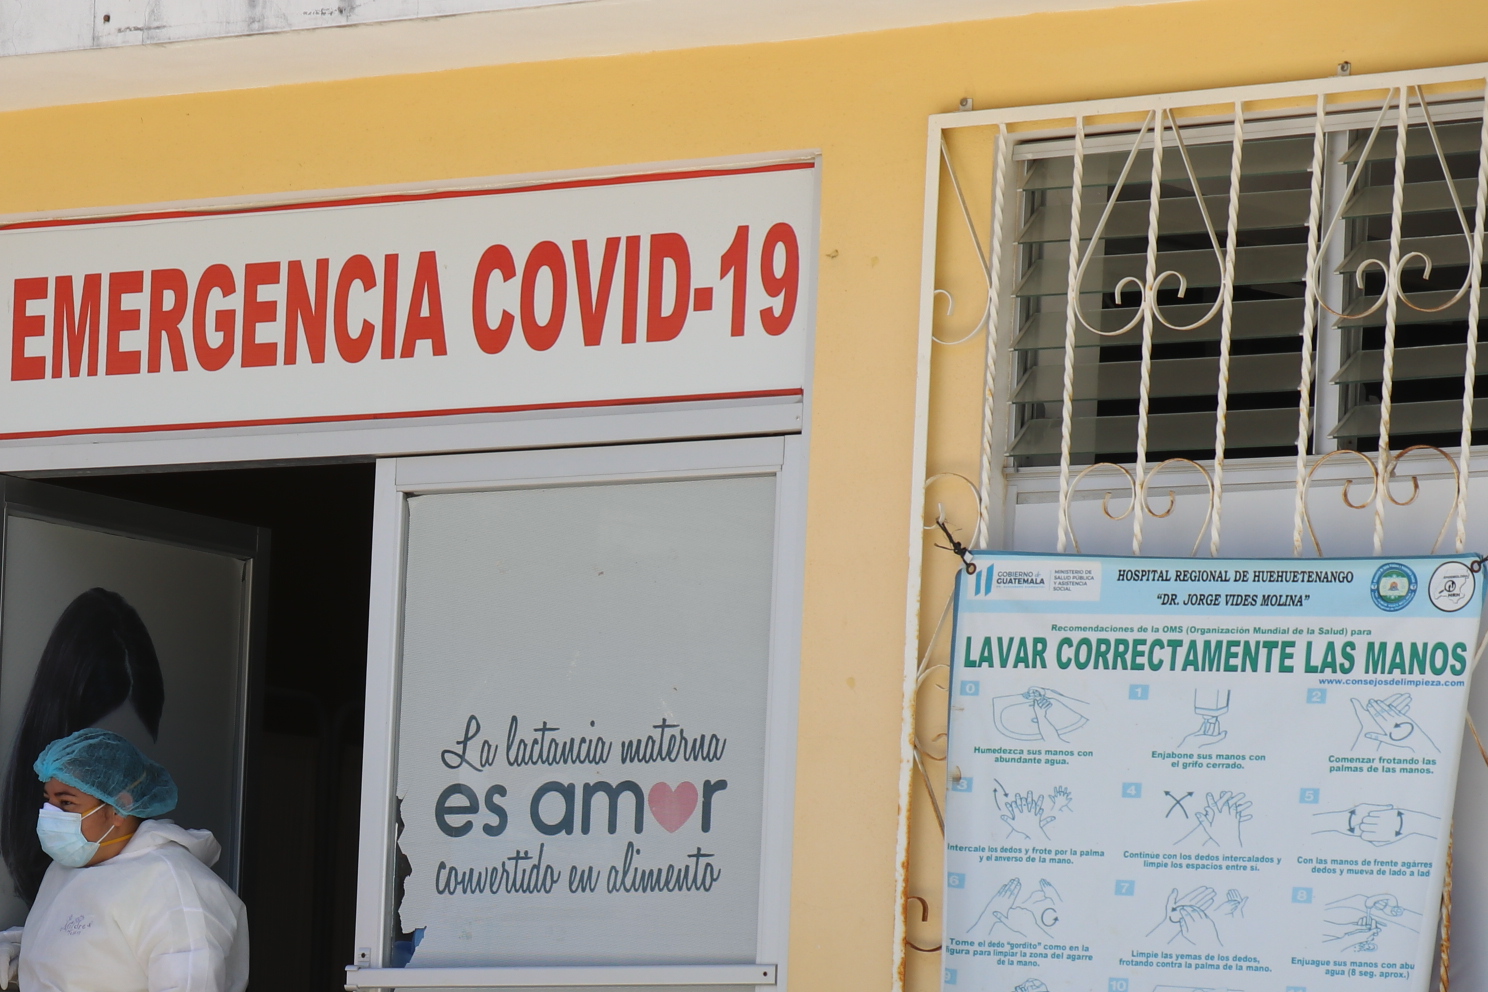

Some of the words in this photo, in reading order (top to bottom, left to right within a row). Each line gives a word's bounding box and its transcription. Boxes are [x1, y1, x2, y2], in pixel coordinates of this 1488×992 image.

[10, 250, 448, 382] EMERGENCIA
[472, 221, 799, 356] COVID-19
[1116, 569, 1171, 581] HOSPITAL
[1174, 569, 1230, 582] REGIONAL
[1233, 570, 1248, 582] DE
[1252, 570, 1353, 582] HUEHUETENANGO
[1183, 593, 1221, 605] JORGE
[1225, 593, 1257, 606] VIDES
[1051, 624, 1134, 632] Recomendaciones
[1137, 625, 1148, 633] de
[1151, 625, 1159, 633] la
[1162, 625, 1183, 633] OMS
[1186, 626, 1249, 635] (Organización
[1253, 626, 1289, 634] Mundial
[1318, 627, 1347, 635] Salud)
[964, 636, 1047, 668] LAVAR
[1056, 638, 1295, 672] CORRECTAMENTE
[1304, 640, 1356, 673] LAS
[1364, 641, 1467, 675] MANOS
[1319, 678, 1464, 686] www.consejosdelimpieza.com
[966, 683, 975, 693] 0
[1135, 687, 1142, 697] 1
[1312, 691, 1321, 702] 2
[441, 714, 498, 772] La
[506, 715, 612, 767] lactancia
[620, 717, 726, 764] materna
[973, 746, 1023, 754] Humedezca
[1151, 750, 1194, 759] Enjabone
[994, 755, 1042, 763] abundante
[1044, 758, 1068, 766] agua.
[1182, 760, 1203, 769] grifo
[1328, 755, 1375, 763] Comenzar
[1378, 756, 1419, 764] frotando
[1422, 757, 1436, 765] las
[1381, 765, 1396, 773] las
[1127, 786, 1136, 796] 4
[1305, 791, 1314, 801] 5
[435, 783, 508, 838] es
[530, 779, 728, 836] amr
[1179, 852, 1192, 860] los
[1194, 853, 1219, 861] dedos
[1222, 854, 1274, 863] intercalados
[1277, 857, 1281, 865] y
[435, 842, 561, 895] convertido
[568, 865, 600, 893] en
[607, 841, 721, 894] alimento
[950, 876, 959, 886] 6
[1121, 883, 1130, 893] 7
[1297, 890, 1307, 900] 8
[1110, 981, 1126, 991] 10
